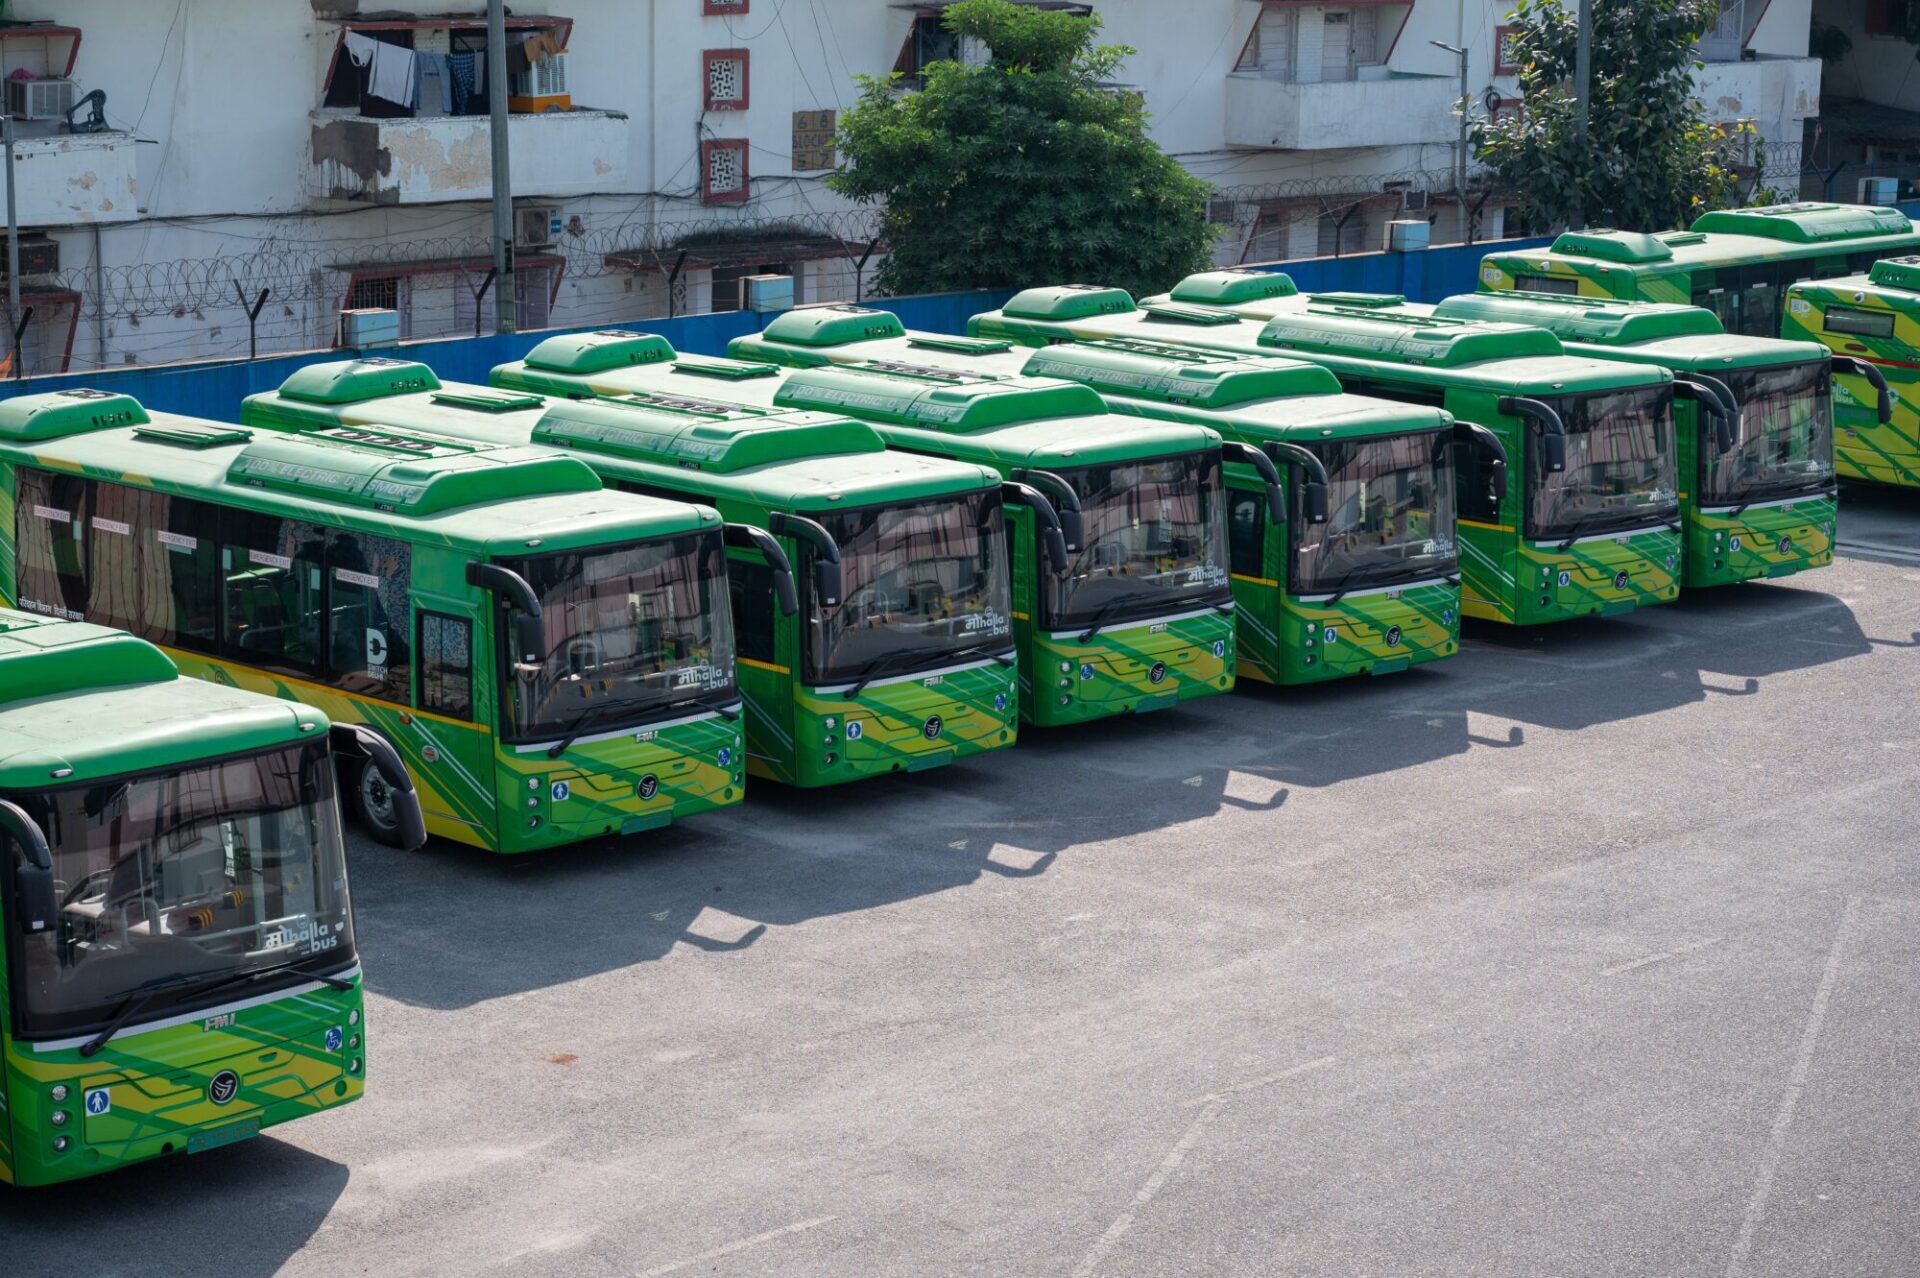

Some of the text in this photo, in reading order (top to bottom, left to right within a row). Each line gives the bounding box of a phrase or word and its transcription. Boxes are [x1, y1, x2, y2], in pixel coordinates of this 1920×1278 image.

[1074, 364, 1134, 382] ELECTRIC
[826, 389, 882, 406] ELECTRIC
[911, 402, 956, 417] SMOKE
[244, 459, 277, 475] 100%
[279, 465, 341, 484] ELECTRIC
[367, 479, 418, 498] SMOKE
[1213, 575, 1229, 587] bus
[993, 625, 1009, 635] bus
[710, 678, 729, 690] bus
[310, 935, 338, 953] bus
